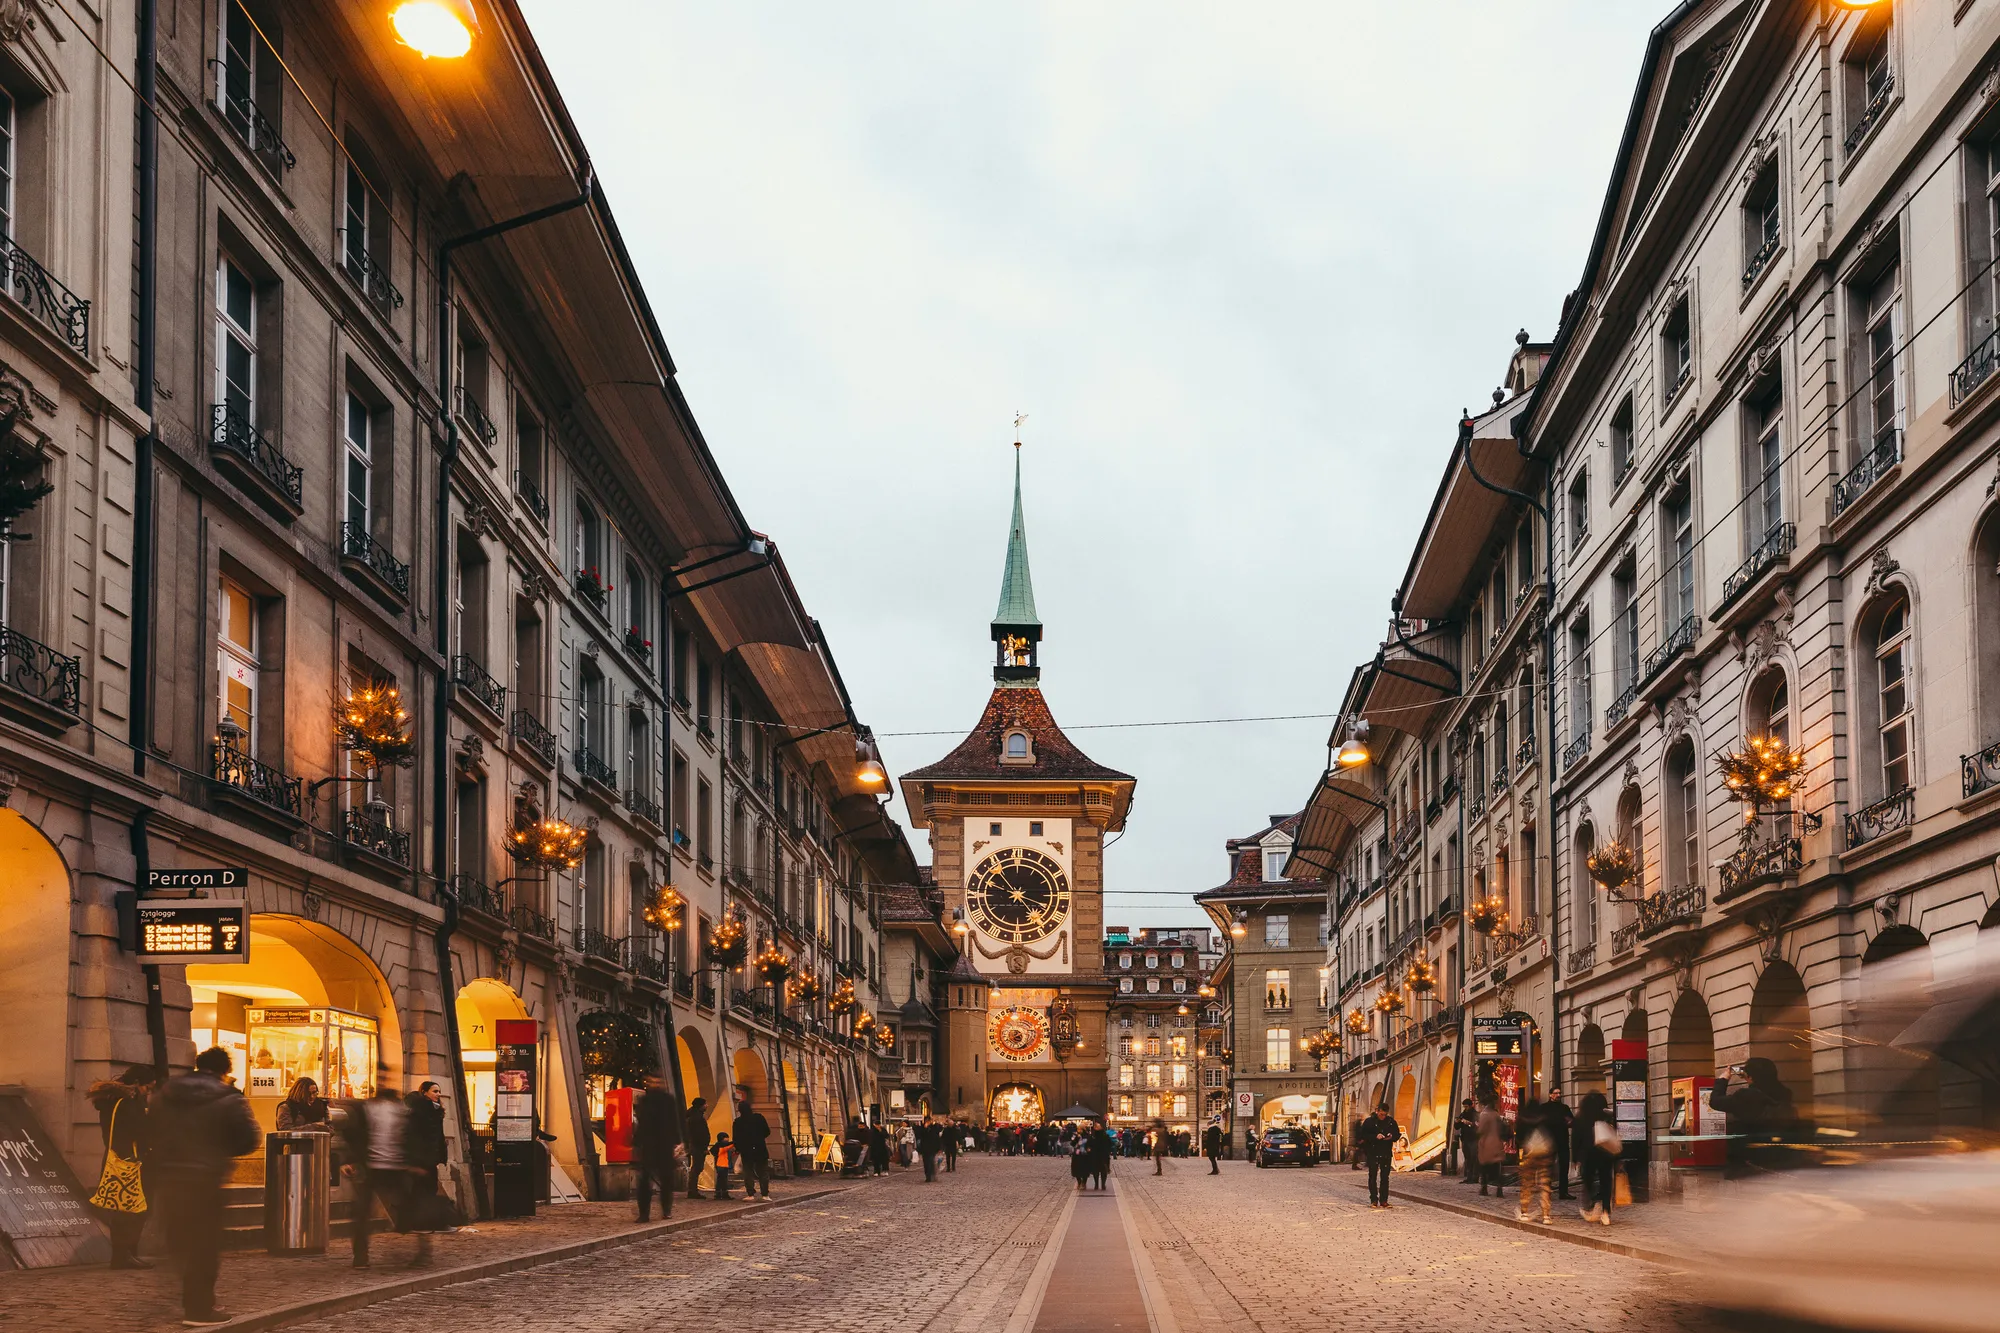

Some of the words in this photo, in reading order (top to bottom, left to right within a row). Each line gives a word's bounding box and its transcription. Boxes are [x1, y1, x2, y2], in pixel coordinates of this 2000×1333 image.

[149, 871, 213, 885] Perron
[222, 871, 235, 885] D
[141, 910, 176, 918] Zytglogge
[145, 925, 155, 934] 12
[155, 925, 181, 934] Zentrum
[181, 925, 196, 934] Paul
[197, 925, 212, 934] Klee
[145, 934, 155, 942] 12
[155, 934, 181, 942] Zentrum
[181, 934, 196, 942] Paul
[197, 934, 212, 942] Klee
[145, 942, 155, 951] 12
[155, 942, 181, 951] Zentrum
[181, 942, 196, 951] Paul
[197, 942, 212, 951] Klee
[1477, 1018, 1508, 1026] Perron
[472, 1025, 484, 1033] 71
[253, 1077, 275, 1087] äuä
